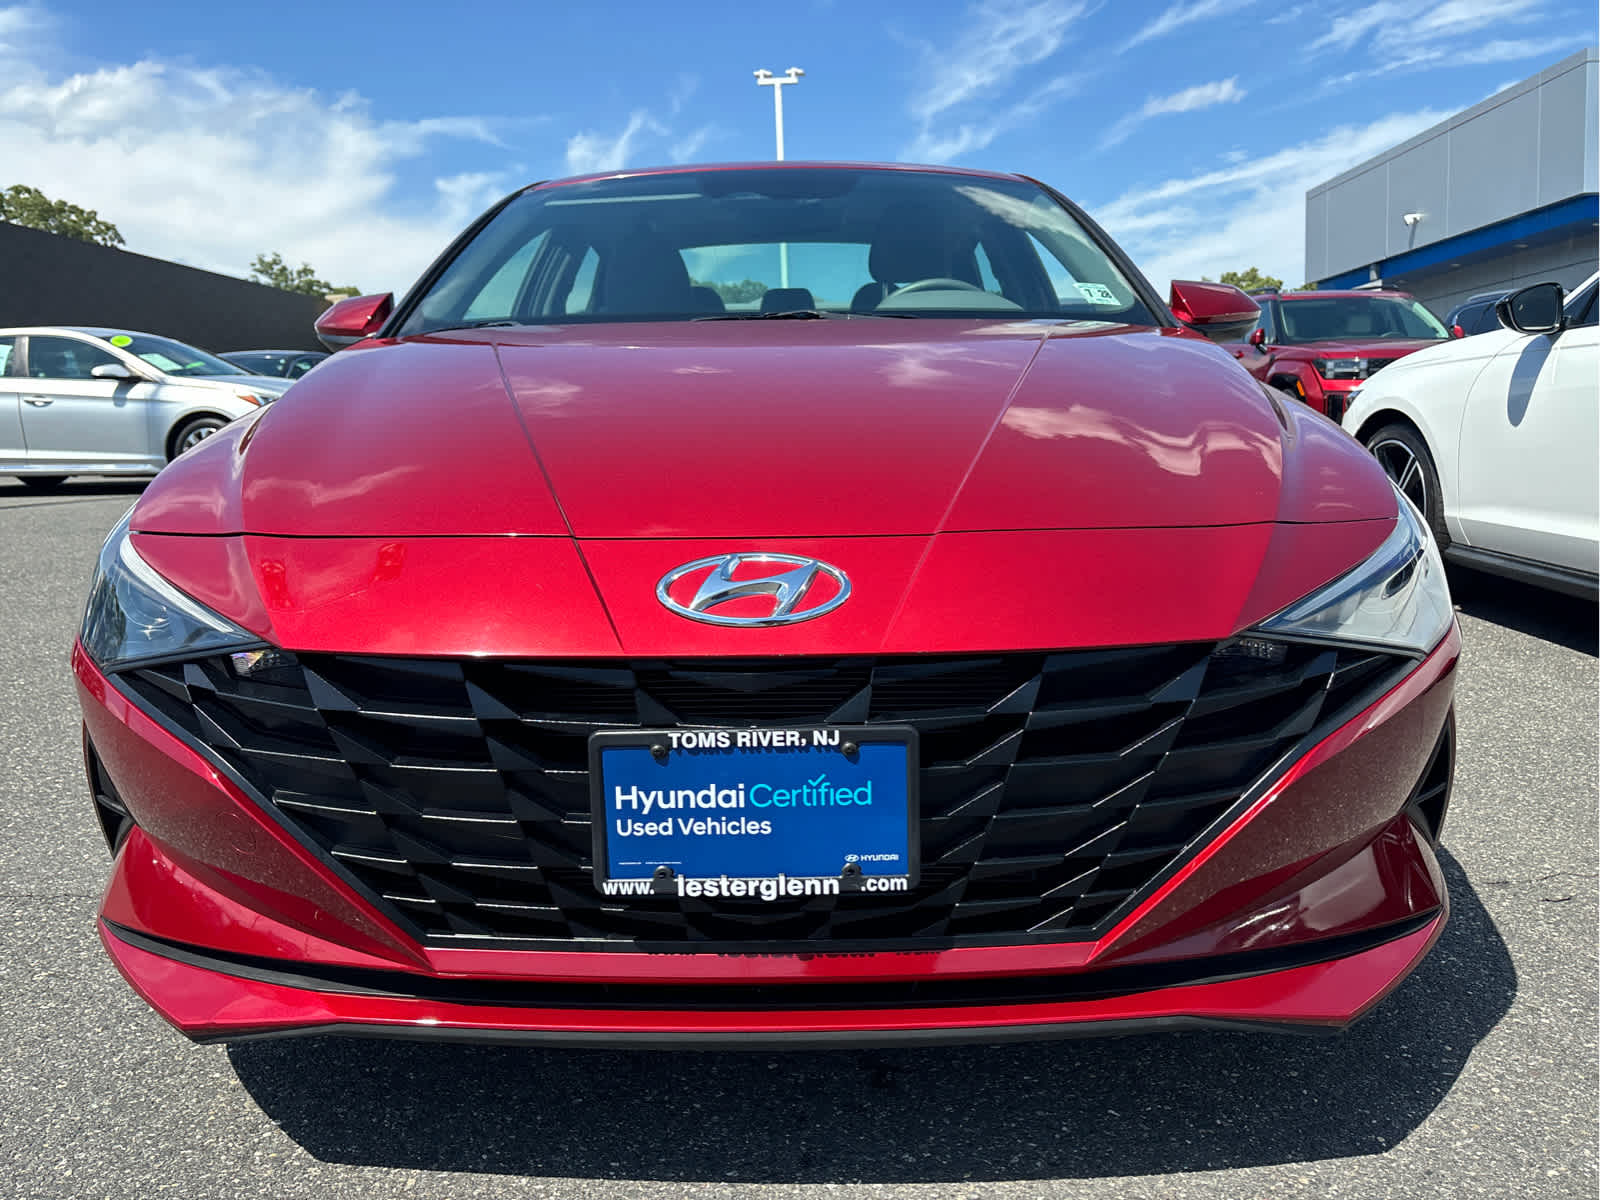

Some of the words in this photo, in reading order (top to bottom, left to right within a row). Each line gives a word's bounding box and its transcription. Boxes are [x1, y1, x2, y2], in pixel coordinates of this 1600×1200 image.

[669, 732, 730, 748] TOMS
[737, 730, 807, 747] RIVER,
[812, 730, 840, 746] NJ
[614, 784, 746, 814] Hyundai
[749, 773, 873, 808] Certified
[616, 818, 674, 836] Used
[677, 817, 772, 835] Vehicles
[602, 881, 655, 895] www.
[677, 873, 840, 900] lesterglenn
[860, 877, 908, 892] .com
